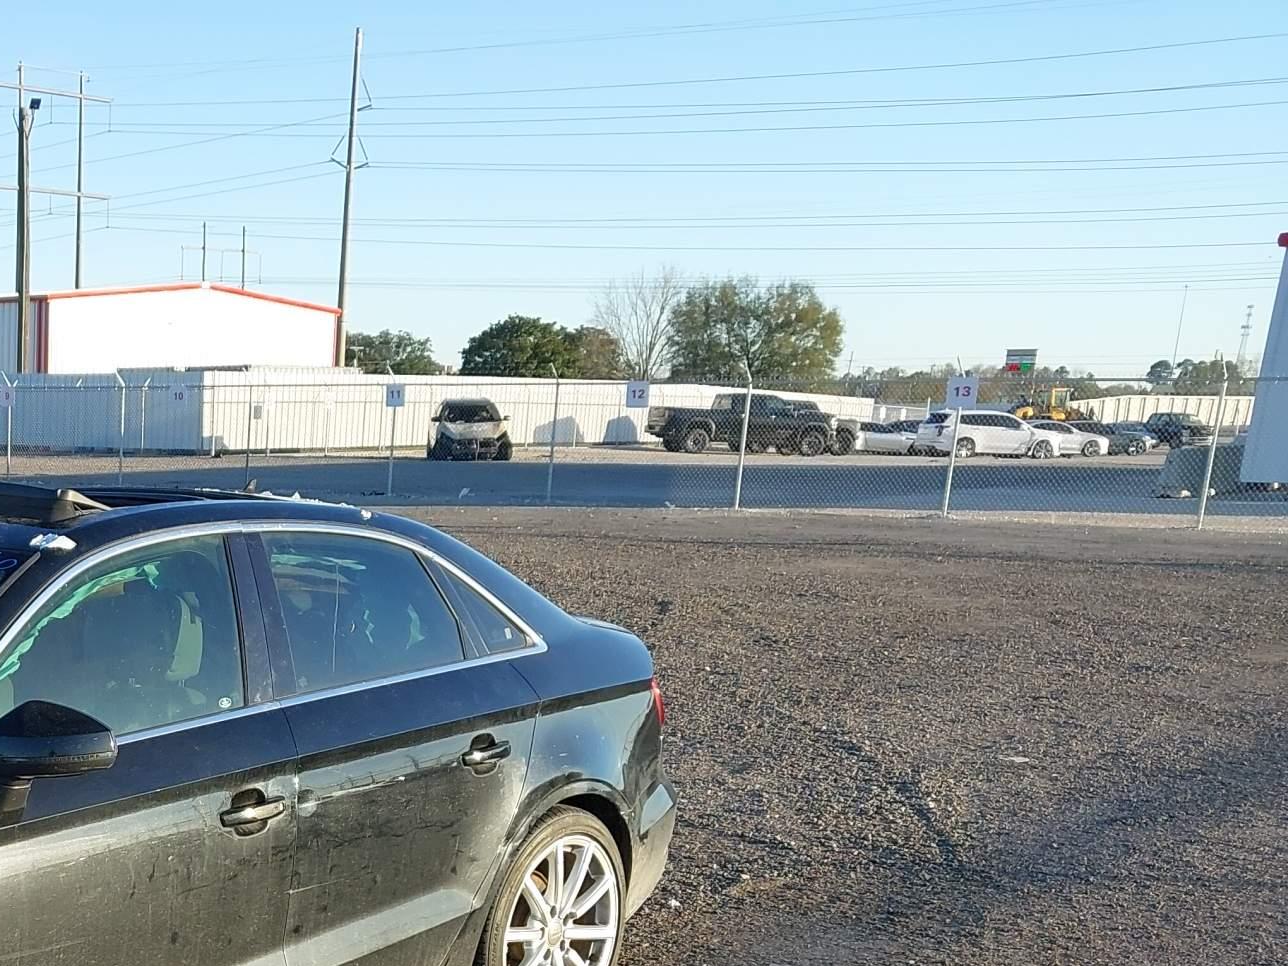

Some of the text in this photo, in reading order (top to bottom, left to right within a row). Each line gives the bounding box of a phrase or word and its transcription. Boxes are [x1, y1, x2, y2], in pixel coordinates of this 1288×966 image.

[174, 391, 184, 401] 10
[390, 390, 401, 399] 11
[632, 389, 645, 399] 12
[953, 386, 971, 397] 13
